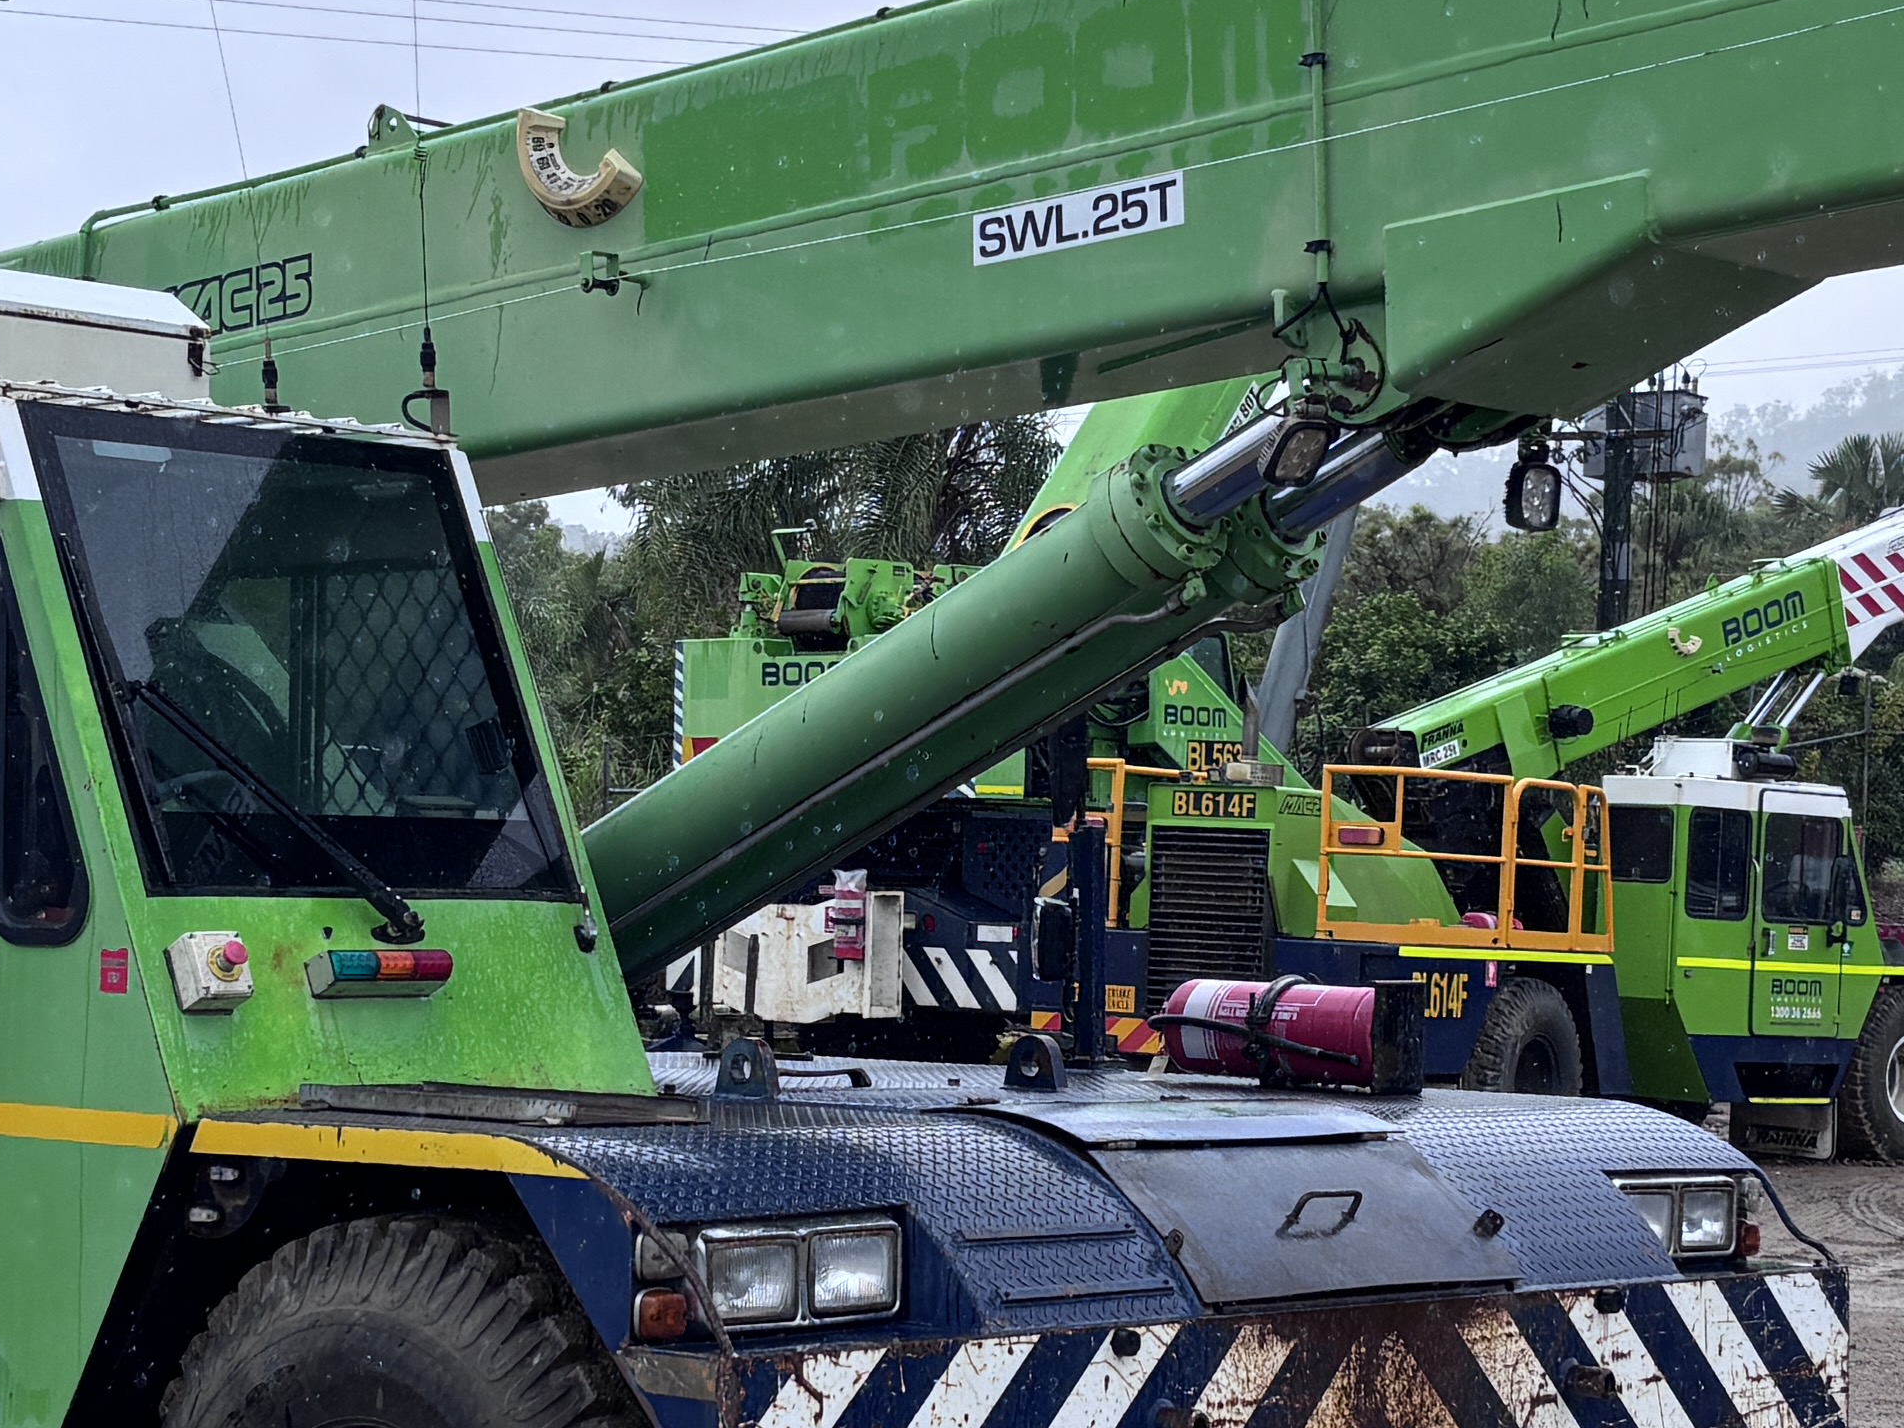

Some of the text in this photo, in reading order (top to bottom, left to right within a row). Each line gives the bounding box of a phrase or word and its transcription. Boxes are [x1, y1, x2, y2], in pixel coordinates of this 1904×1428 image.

[979, 179, 1177, 258] SWL.25T
[1722, 590, 1805, 647] BOOM
[1726, 620, 1808, 662] LOGISTICS
[762, 661, 840, 686] BOO
[1164, 704, 1227, 728] BOOM
[1421, 718, 1464, 754] FRANNA
[1174, 792, 1256, 816] BL614F
[1771, 979, 1822, 996] BOOM
